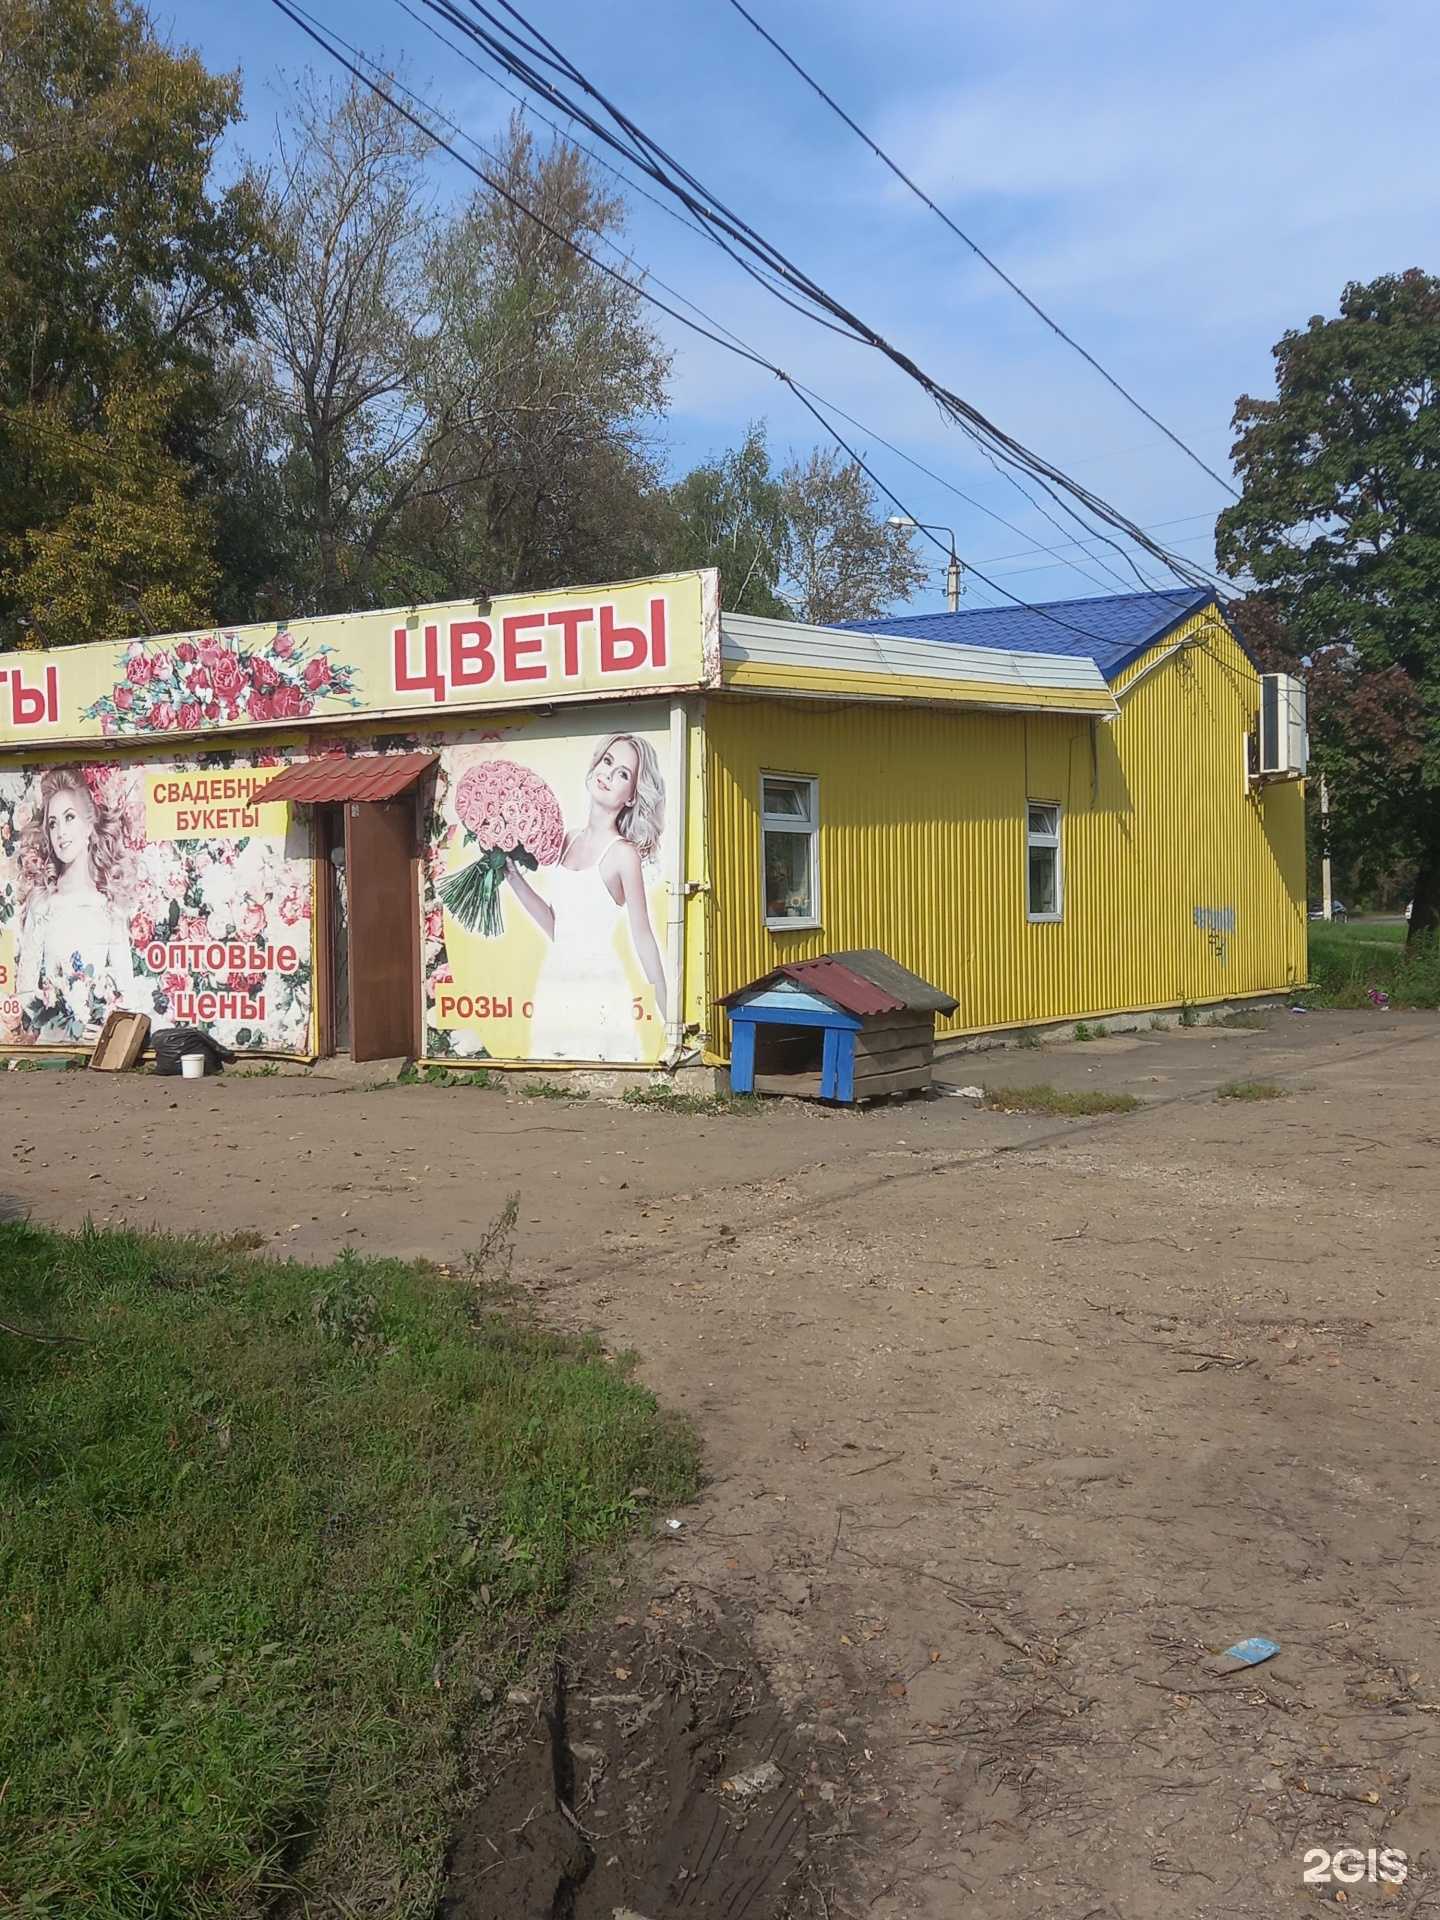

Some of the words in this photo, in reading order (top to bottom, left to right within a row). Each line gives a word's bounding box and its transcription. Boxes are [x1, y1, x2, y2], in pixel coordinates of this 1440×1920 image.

[394, 598, 666, 702] ЦВЕТЫ
[0, 666, 58, 725] Ы
[153, 776, 278, 805] СВАДЕБНЫ
[176, 807, 259, 831] БУКЕТЫ
[147, 943, 297, 971] оптовые
[176, 993, 266, 1024] цены
[441, 996, 513, 1018] РОЗЫ
